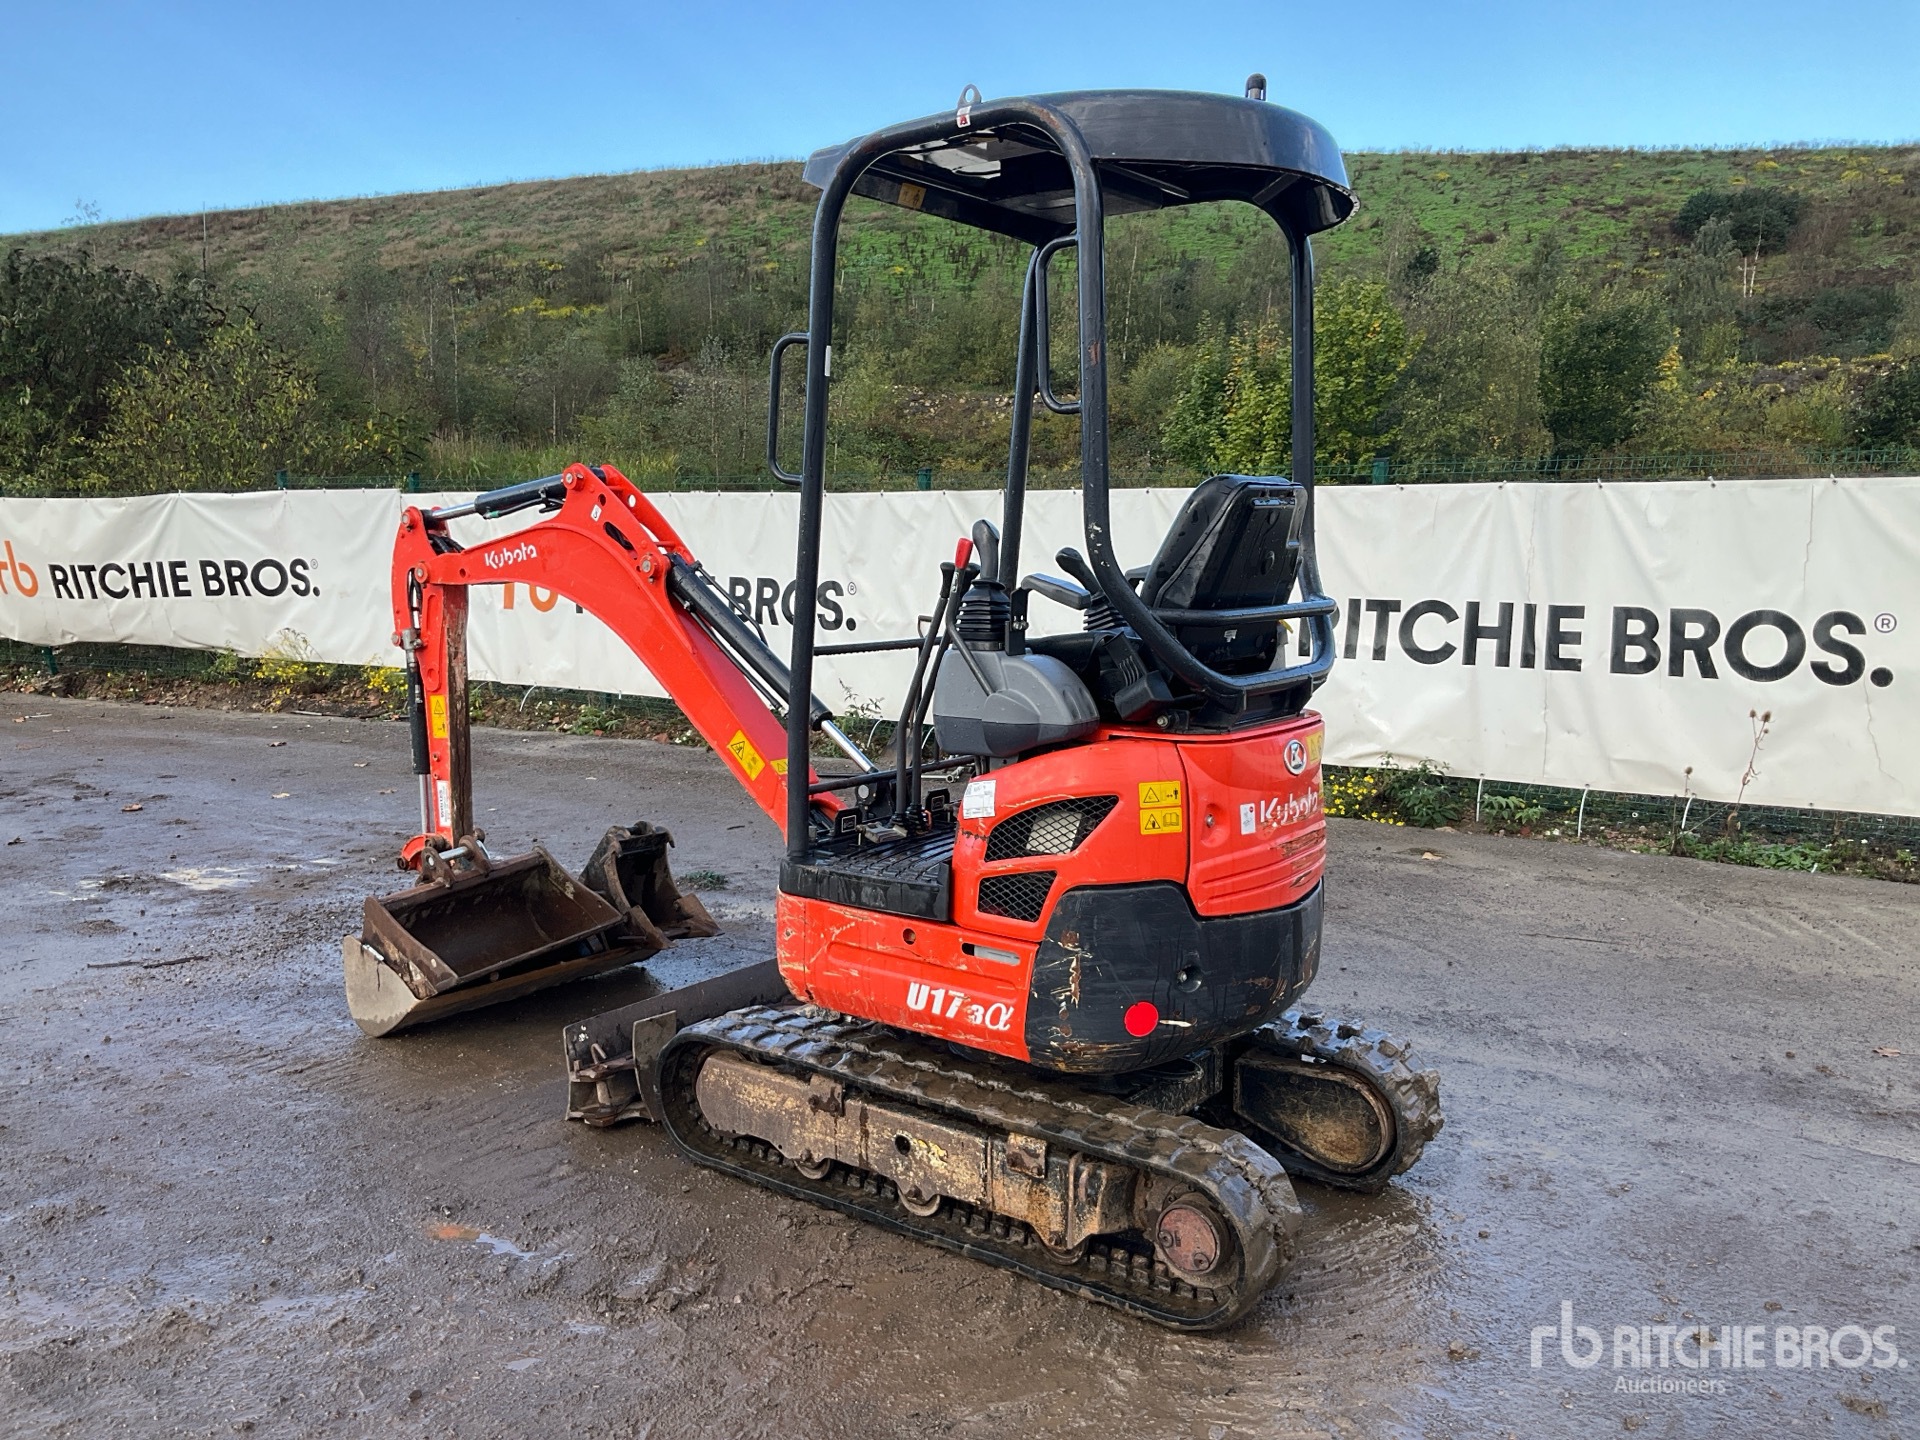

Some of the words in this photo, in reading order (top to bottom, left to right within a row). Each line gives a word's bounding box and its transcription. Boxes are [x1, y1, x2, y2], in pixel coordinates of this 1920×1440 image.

[484, 542, 538, 570] Kubota
[48, 560, 192, 600] RITCHIE
[1260, 786, 1318, 826] Kubota
